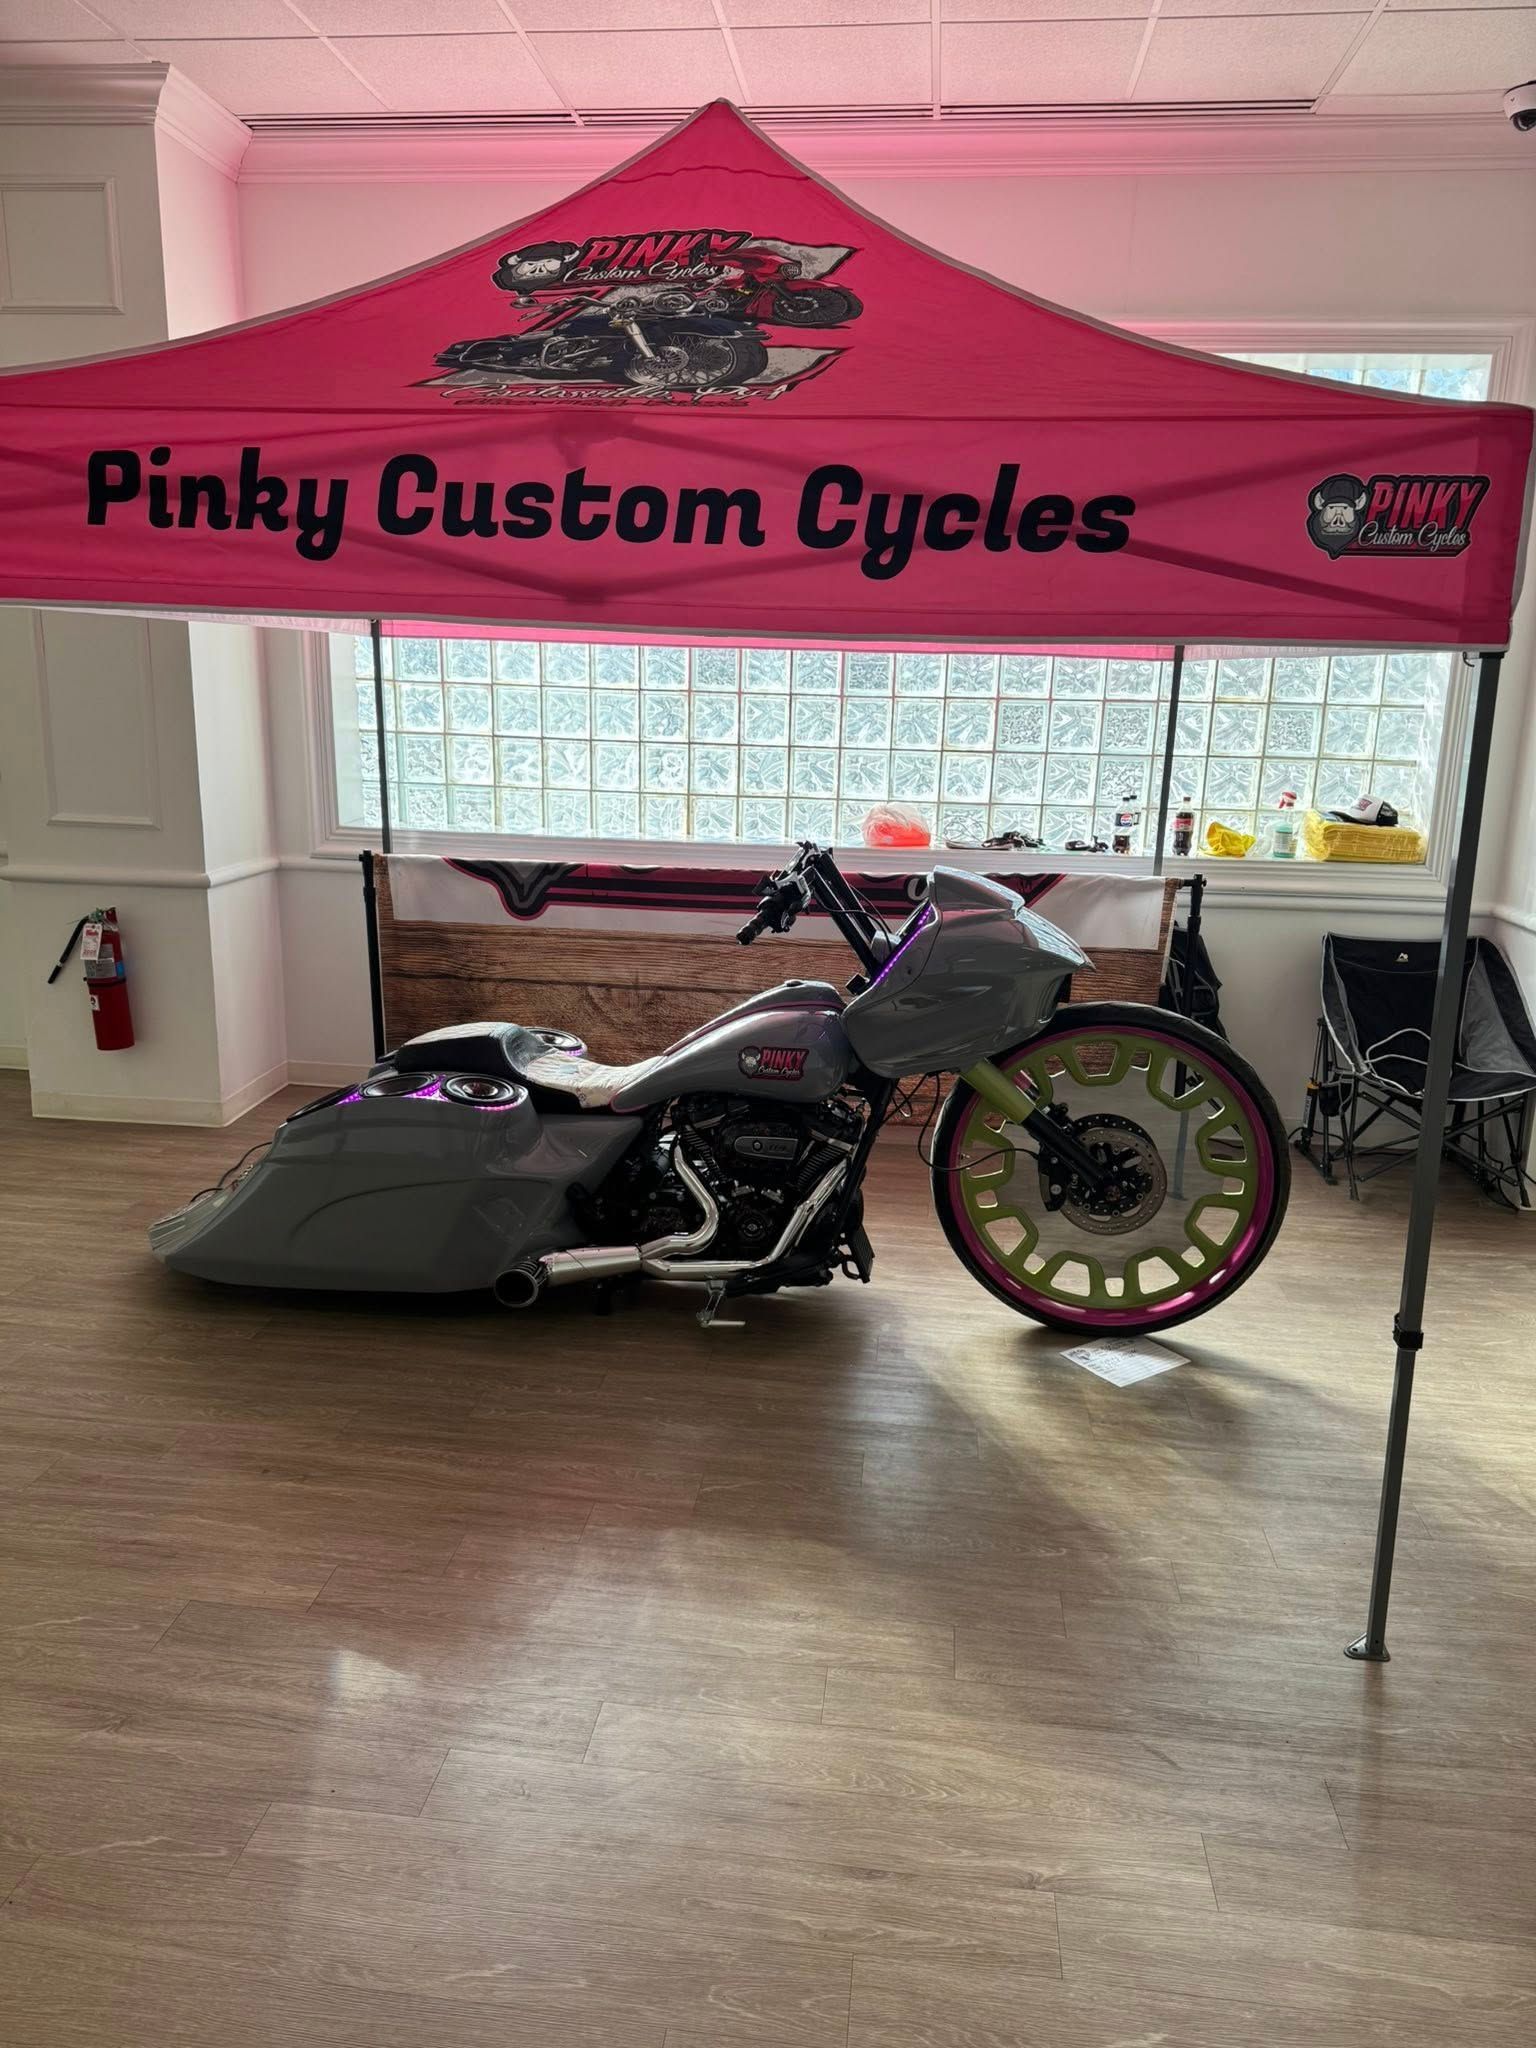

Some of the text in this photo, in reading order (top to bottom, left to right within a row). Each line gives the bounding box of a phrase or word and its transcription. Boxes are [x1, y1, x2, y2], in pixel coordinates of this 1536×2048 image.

[563, 259, 718, 284] Custom Cycles
[87, 446, 1136, 580] Pinky Custom Cycles
[1364, 481, 1484, 530] PINKY
[1357, 520, 1468, 552] Custom Cycles
[760, 1048, 806, 1070] PINKY
